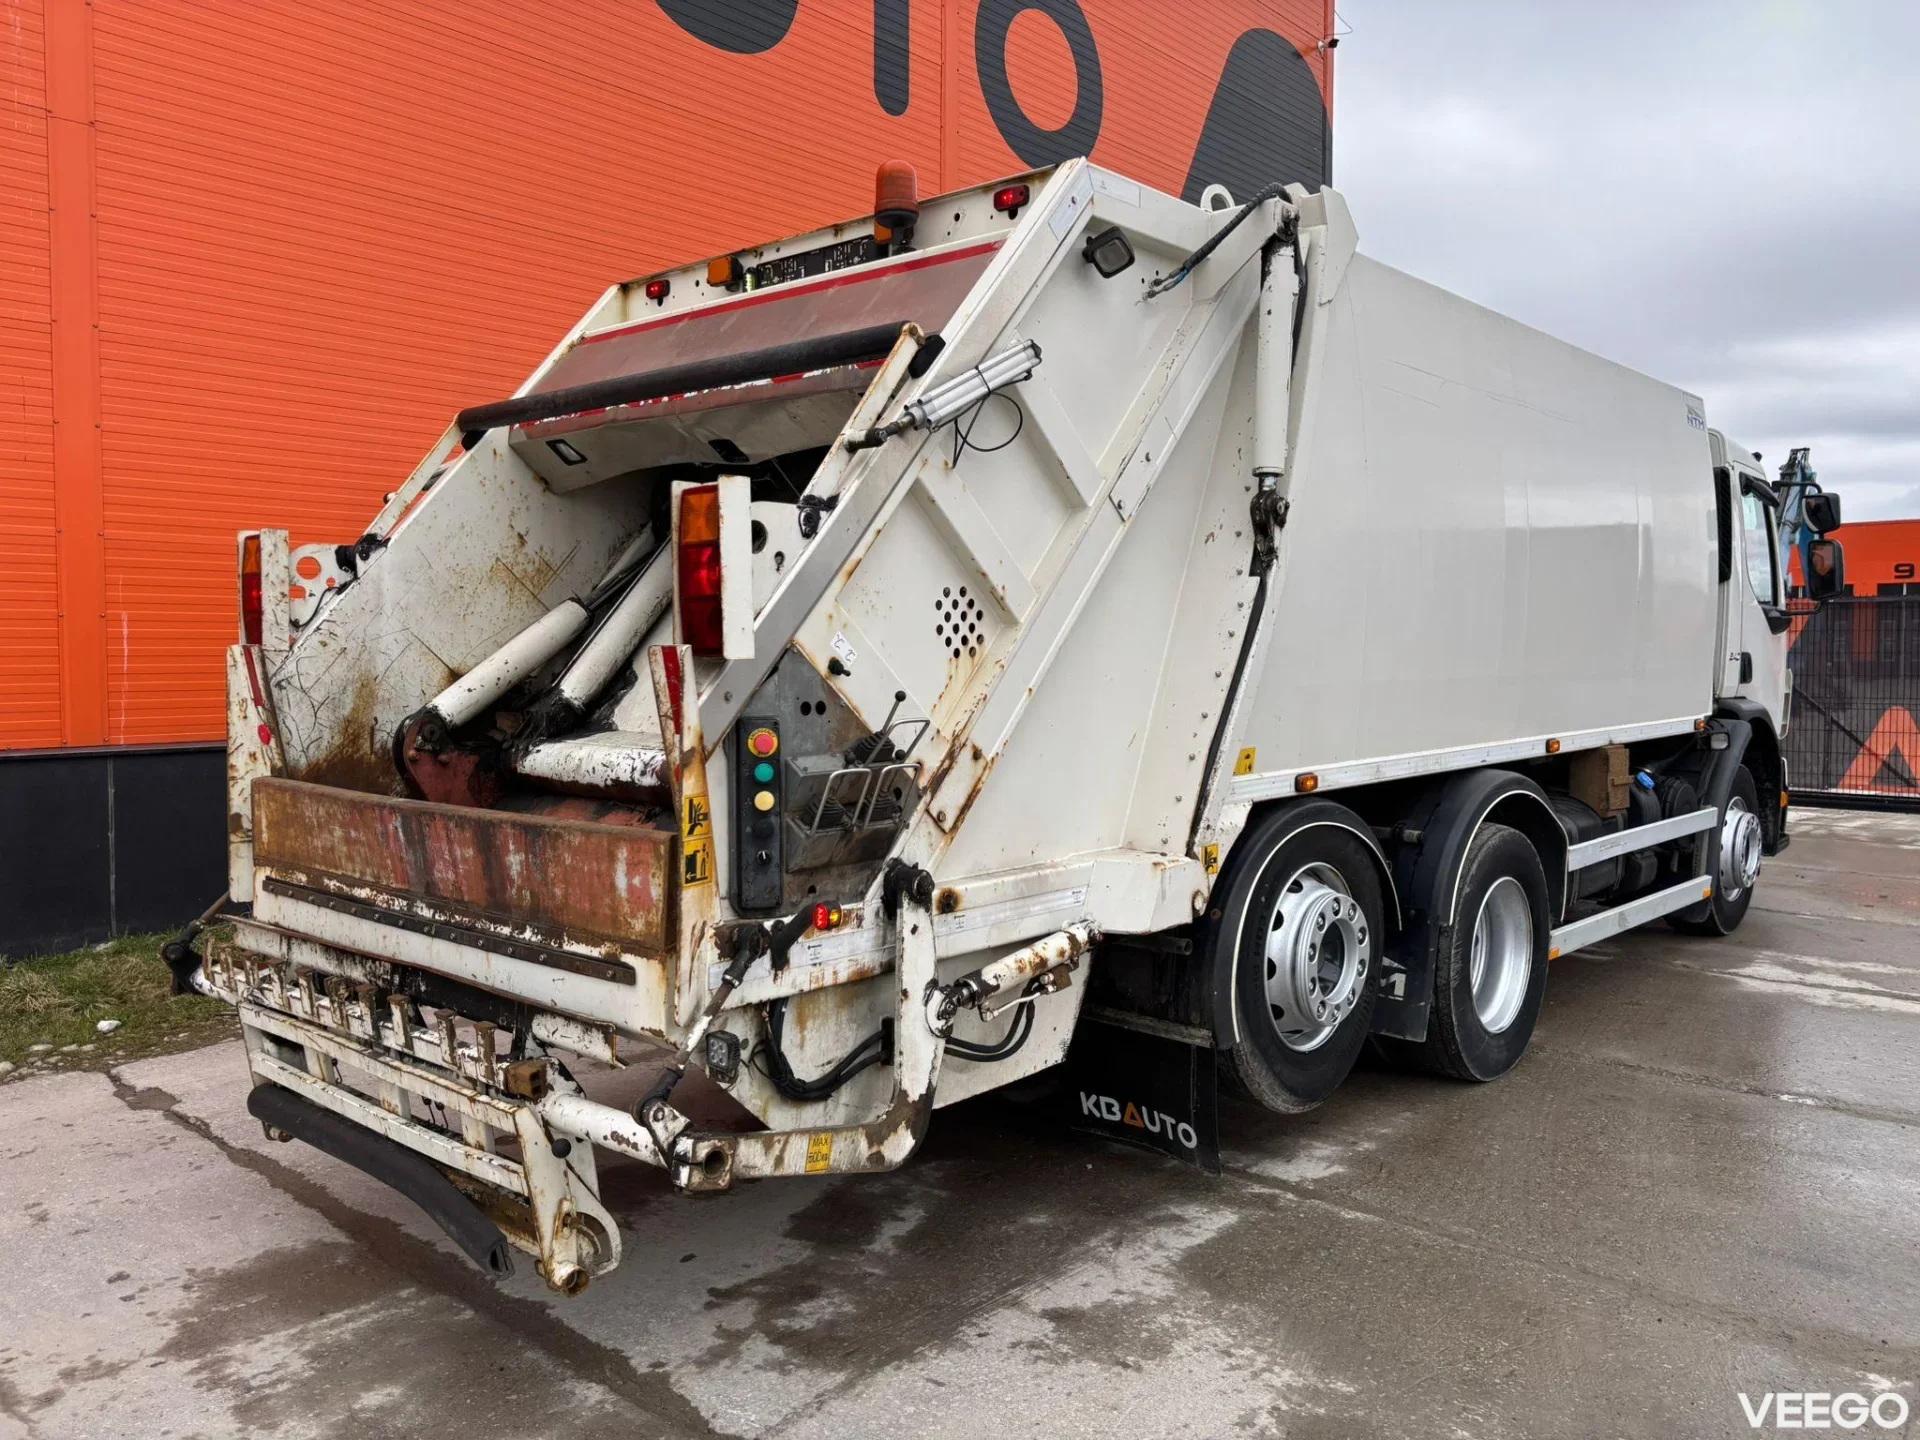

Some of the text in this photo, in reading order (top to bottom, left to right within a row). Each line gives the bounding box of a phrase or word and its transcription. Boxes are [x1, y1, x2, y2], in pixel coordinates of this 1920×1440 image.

[1894, 563, 1915, 579] 9
[1080, 1091, 1198, 1149] KBAUTO
[812, 1136, 829, 1146] MAX
